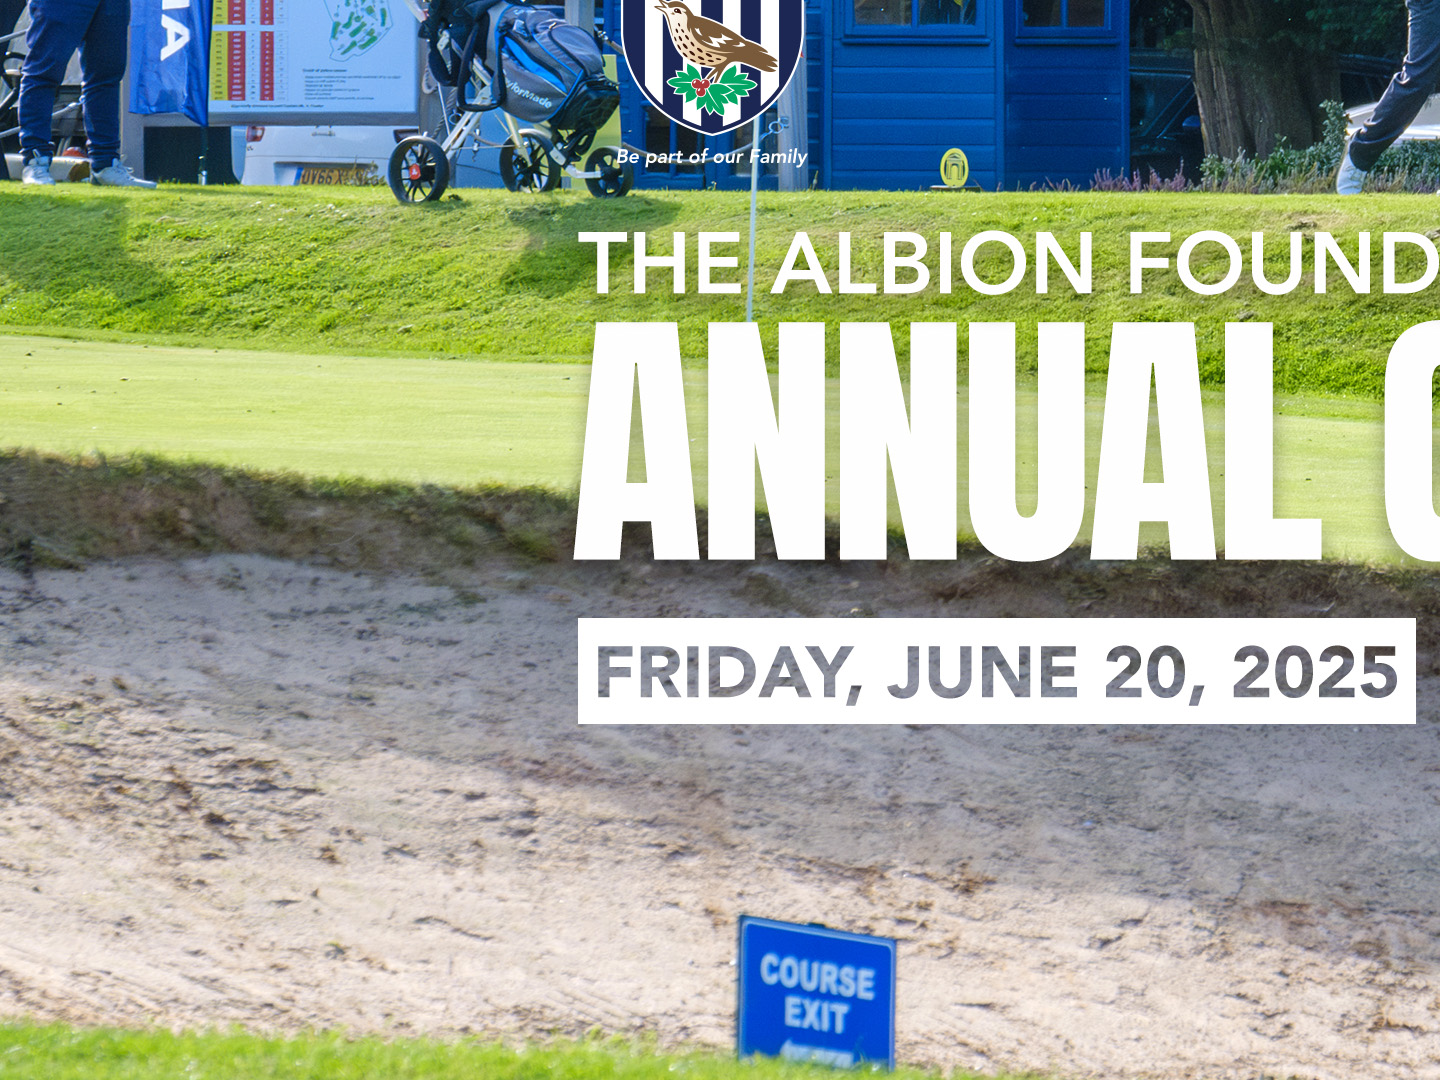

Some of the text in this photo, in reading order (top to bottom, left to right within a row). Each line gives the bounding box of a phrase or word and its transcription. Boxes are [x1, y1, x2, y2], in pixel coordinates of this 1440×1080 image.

[503, 69, 553, 109] ylorMade
[760, 952, 875, 1001] COURSE
[784, 995, 850, 1035] EXIT
